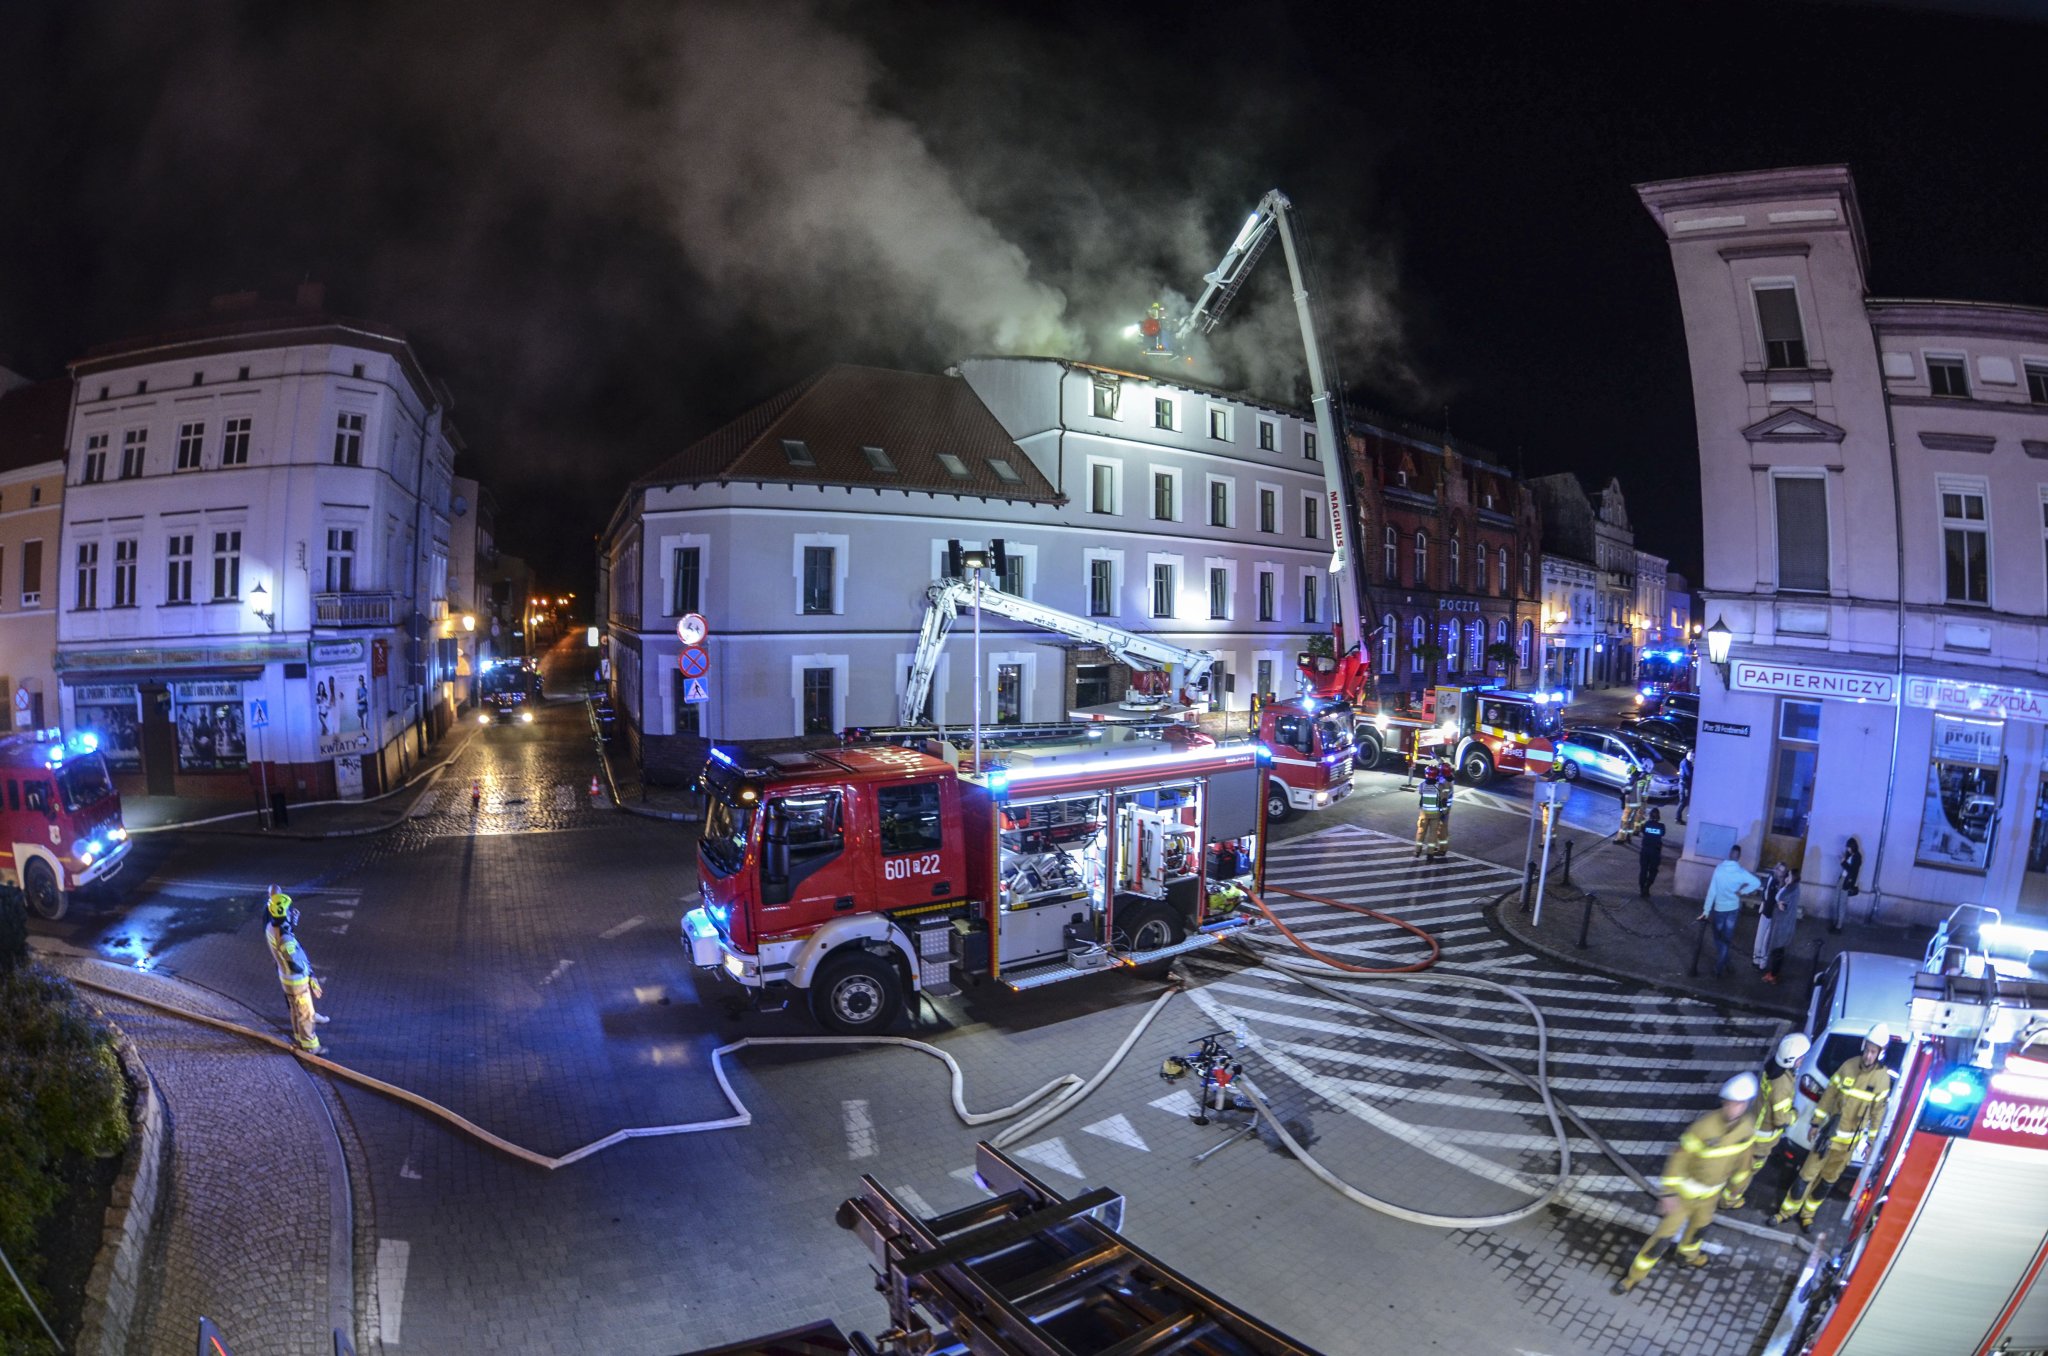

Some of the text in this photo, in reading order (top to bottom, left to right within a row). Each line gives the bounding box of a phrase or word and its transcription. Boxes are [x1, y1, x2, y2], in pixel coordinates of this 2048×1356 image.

[1329, 491, 1344, 548] MAGIRUS
[1439, 599, 1480, 612] POCZTA
[1743, 669, 1886, 695] PAPIERNICZY
[320, 740, 358, 754] KWIATY
[1944, 730, 1993, 747] profit
